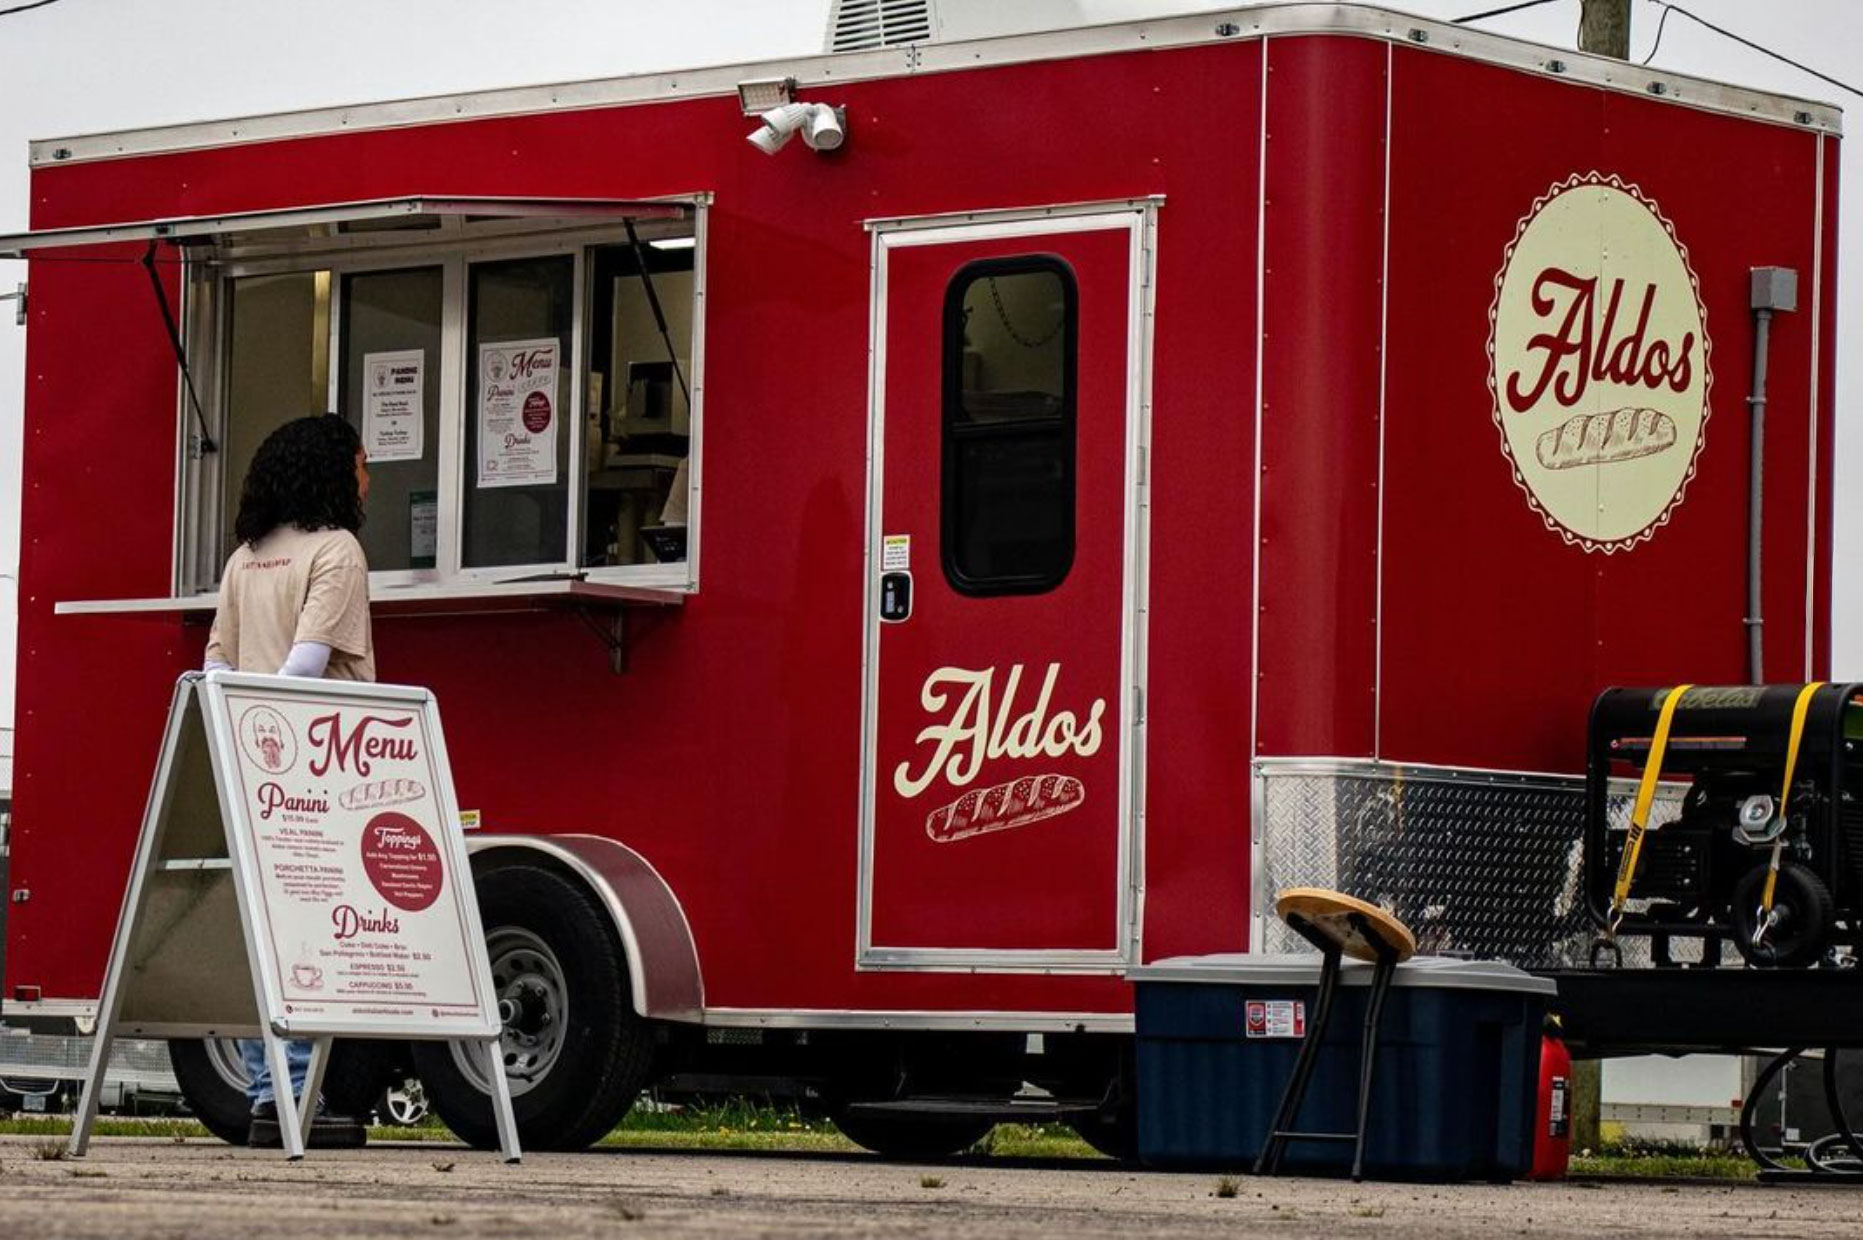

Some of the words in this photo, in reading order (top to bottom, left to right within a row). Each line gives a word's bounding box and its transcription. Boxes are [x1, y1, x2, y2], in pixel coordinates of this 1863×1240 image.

[1506, 267, 1695, 413] Aldos
[509, 349, 553, 380] Menu
[308, 712, 418, 777] Menu
[894, 663, 1106, 798] Aldos
[258, 782, 330, 820] Panini
[374, 827, 421, 850] Toppings
[333, 905, 399, 940] Drinks
